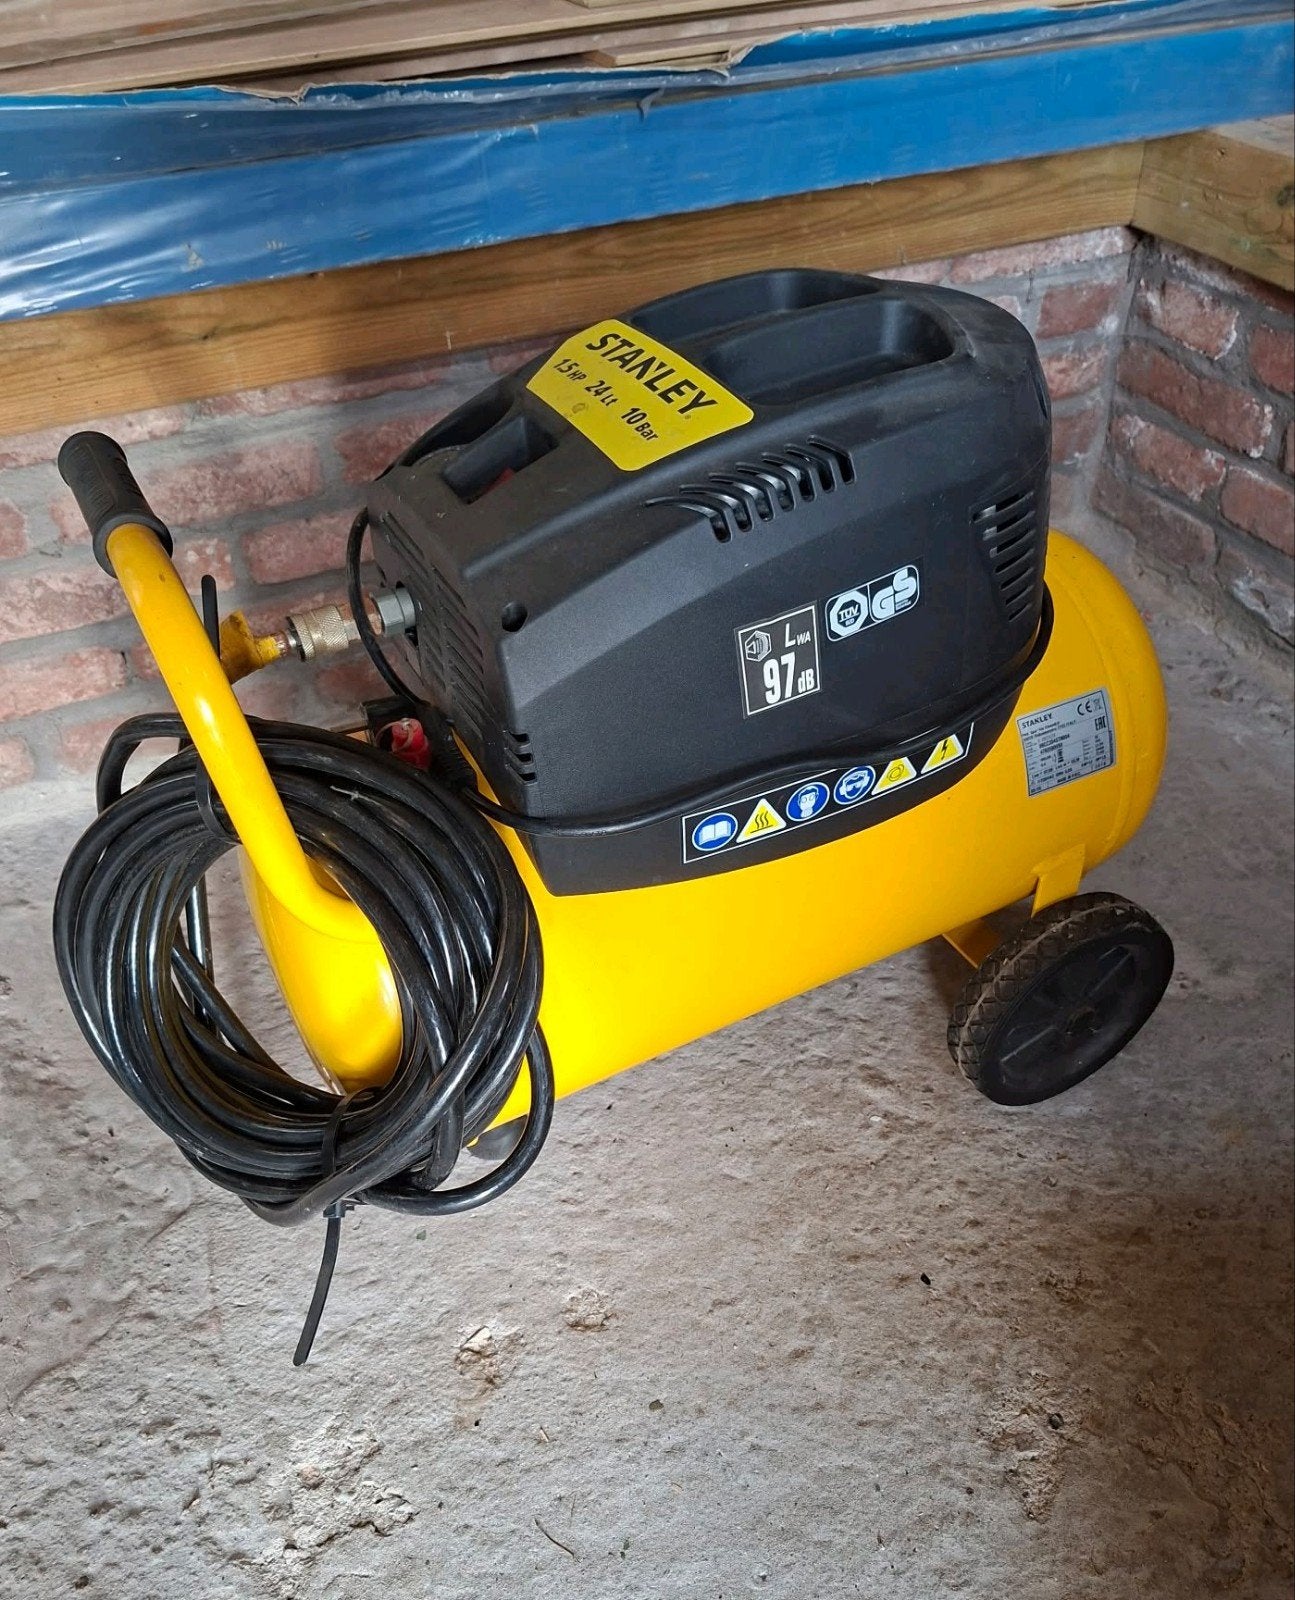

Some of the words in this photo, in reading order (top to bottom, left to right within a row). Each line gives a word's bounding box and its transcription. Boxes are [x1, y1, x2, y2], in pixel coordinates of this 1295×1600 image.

[567, 369, 588, 381] HP
[585, 333, 718, 415] STANLEY
[584, 380, 613, 397] 24
[600, 393, 619, 407] Lt
[621, 407, 648, 425] 10
[634, 422, 659, 441] Bar
[872, 568, 917, 619] GS
[763, 651, 796, 704] 97
[797, 668, 815, 694] dB
[1077, 700, 1093, 716] CE
[1022, 713, 1053, 728] STANLEY
